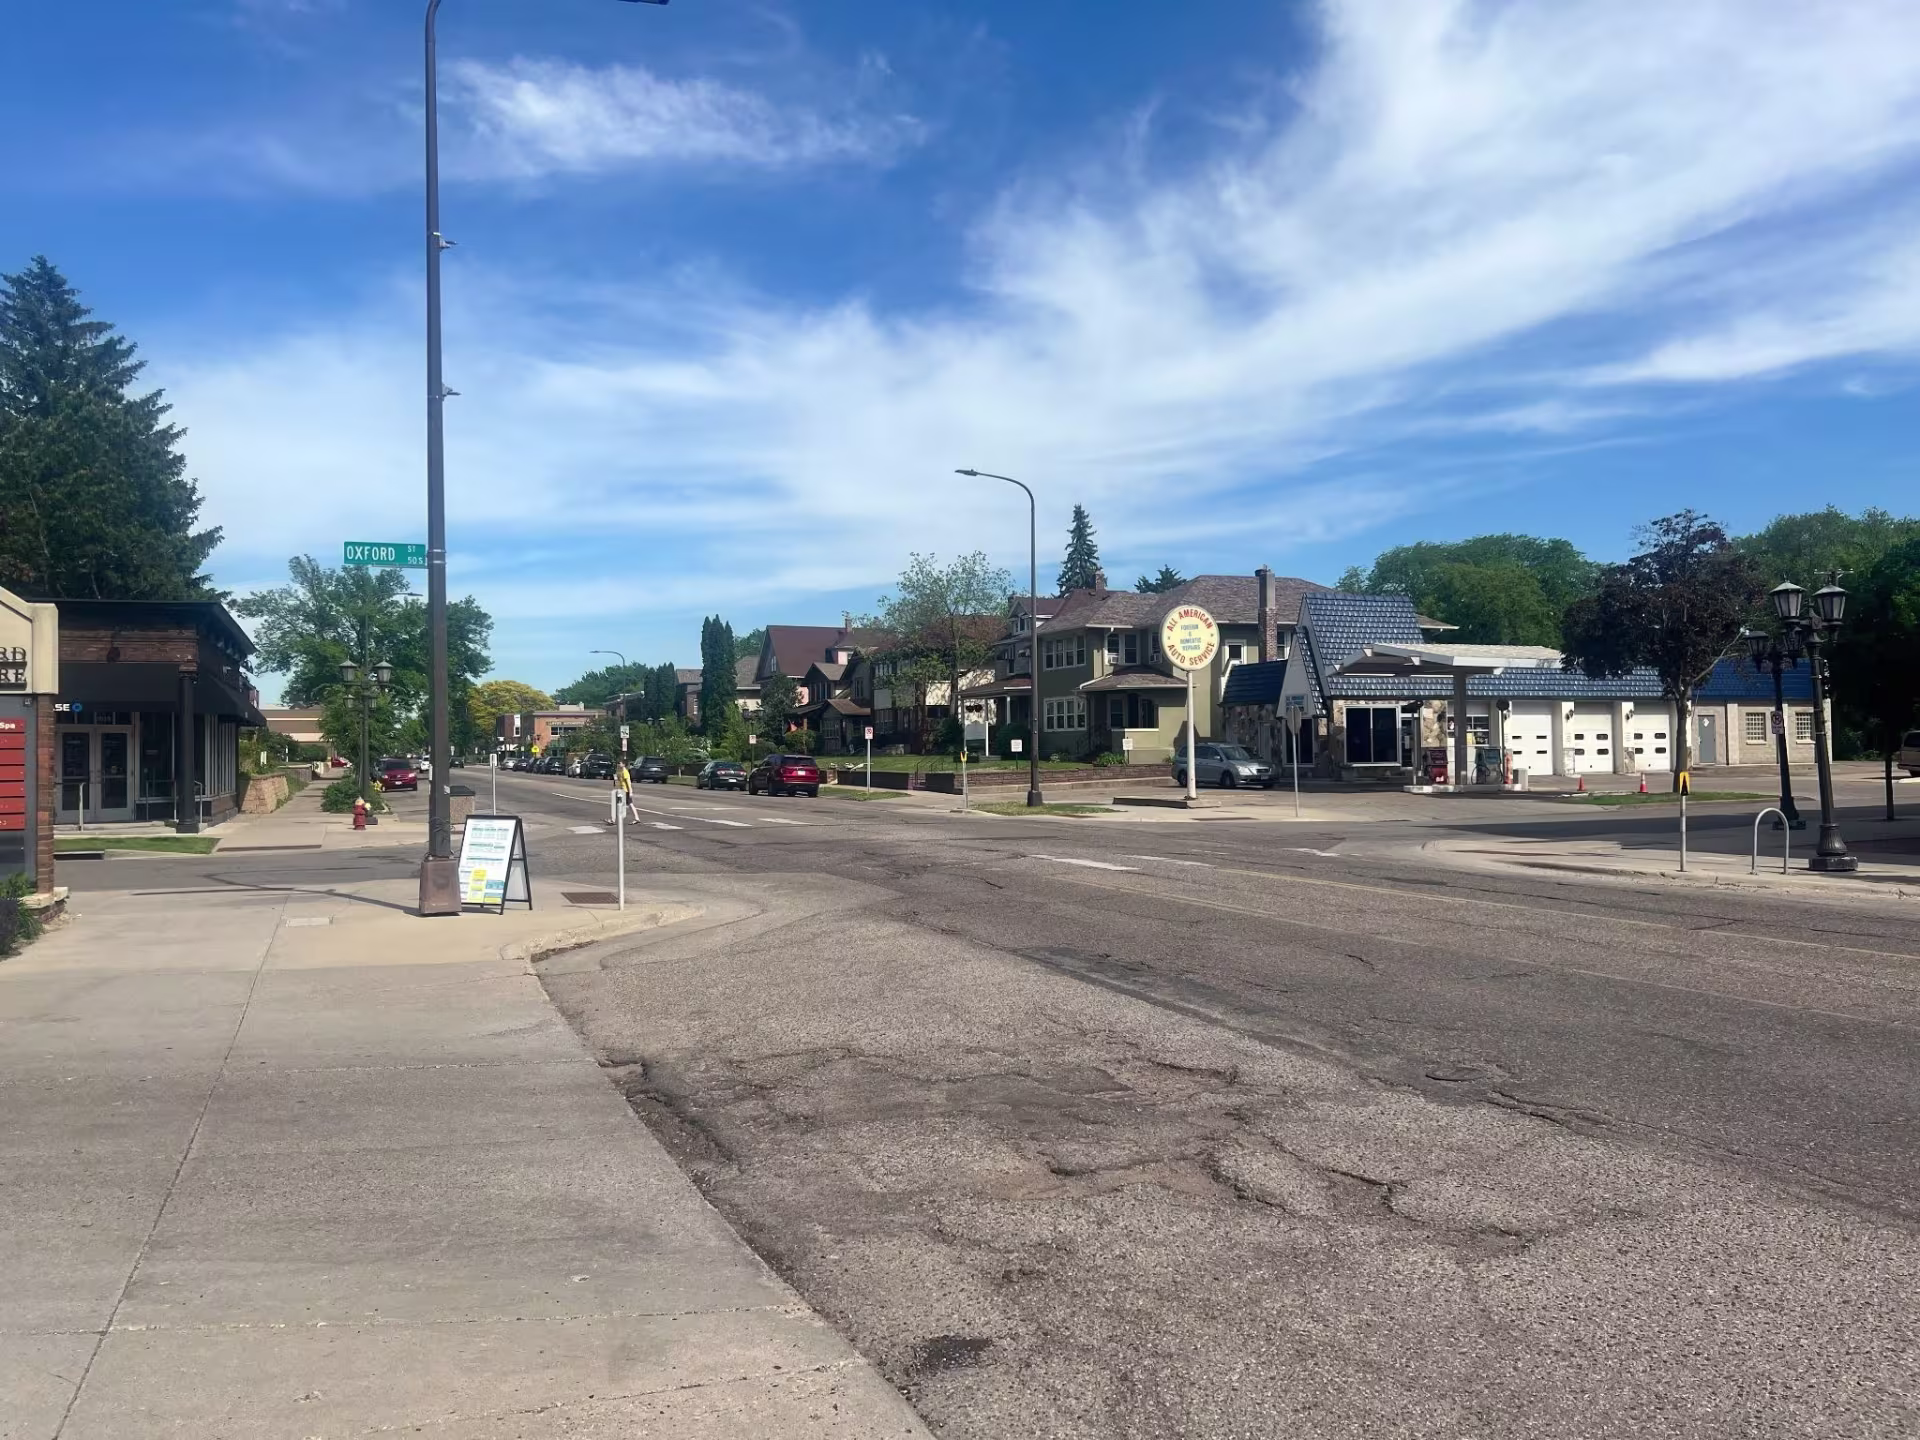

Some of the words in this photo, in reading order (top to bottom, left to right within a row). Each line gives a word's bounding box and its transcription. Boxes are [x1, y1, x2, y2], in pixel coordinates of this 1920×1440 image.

[346, 546, 396, 561] OXFORD
[407, 545, 416, 553] ST
[1167, 618, 1178, 632] ALL
[1178, 609, 1213, 629] AMERICAN
[1167, 644, 1186, 664] AUTO
[1189, 642, 1215, 666] SERVICE
[53, 703, 71, 712] SE
